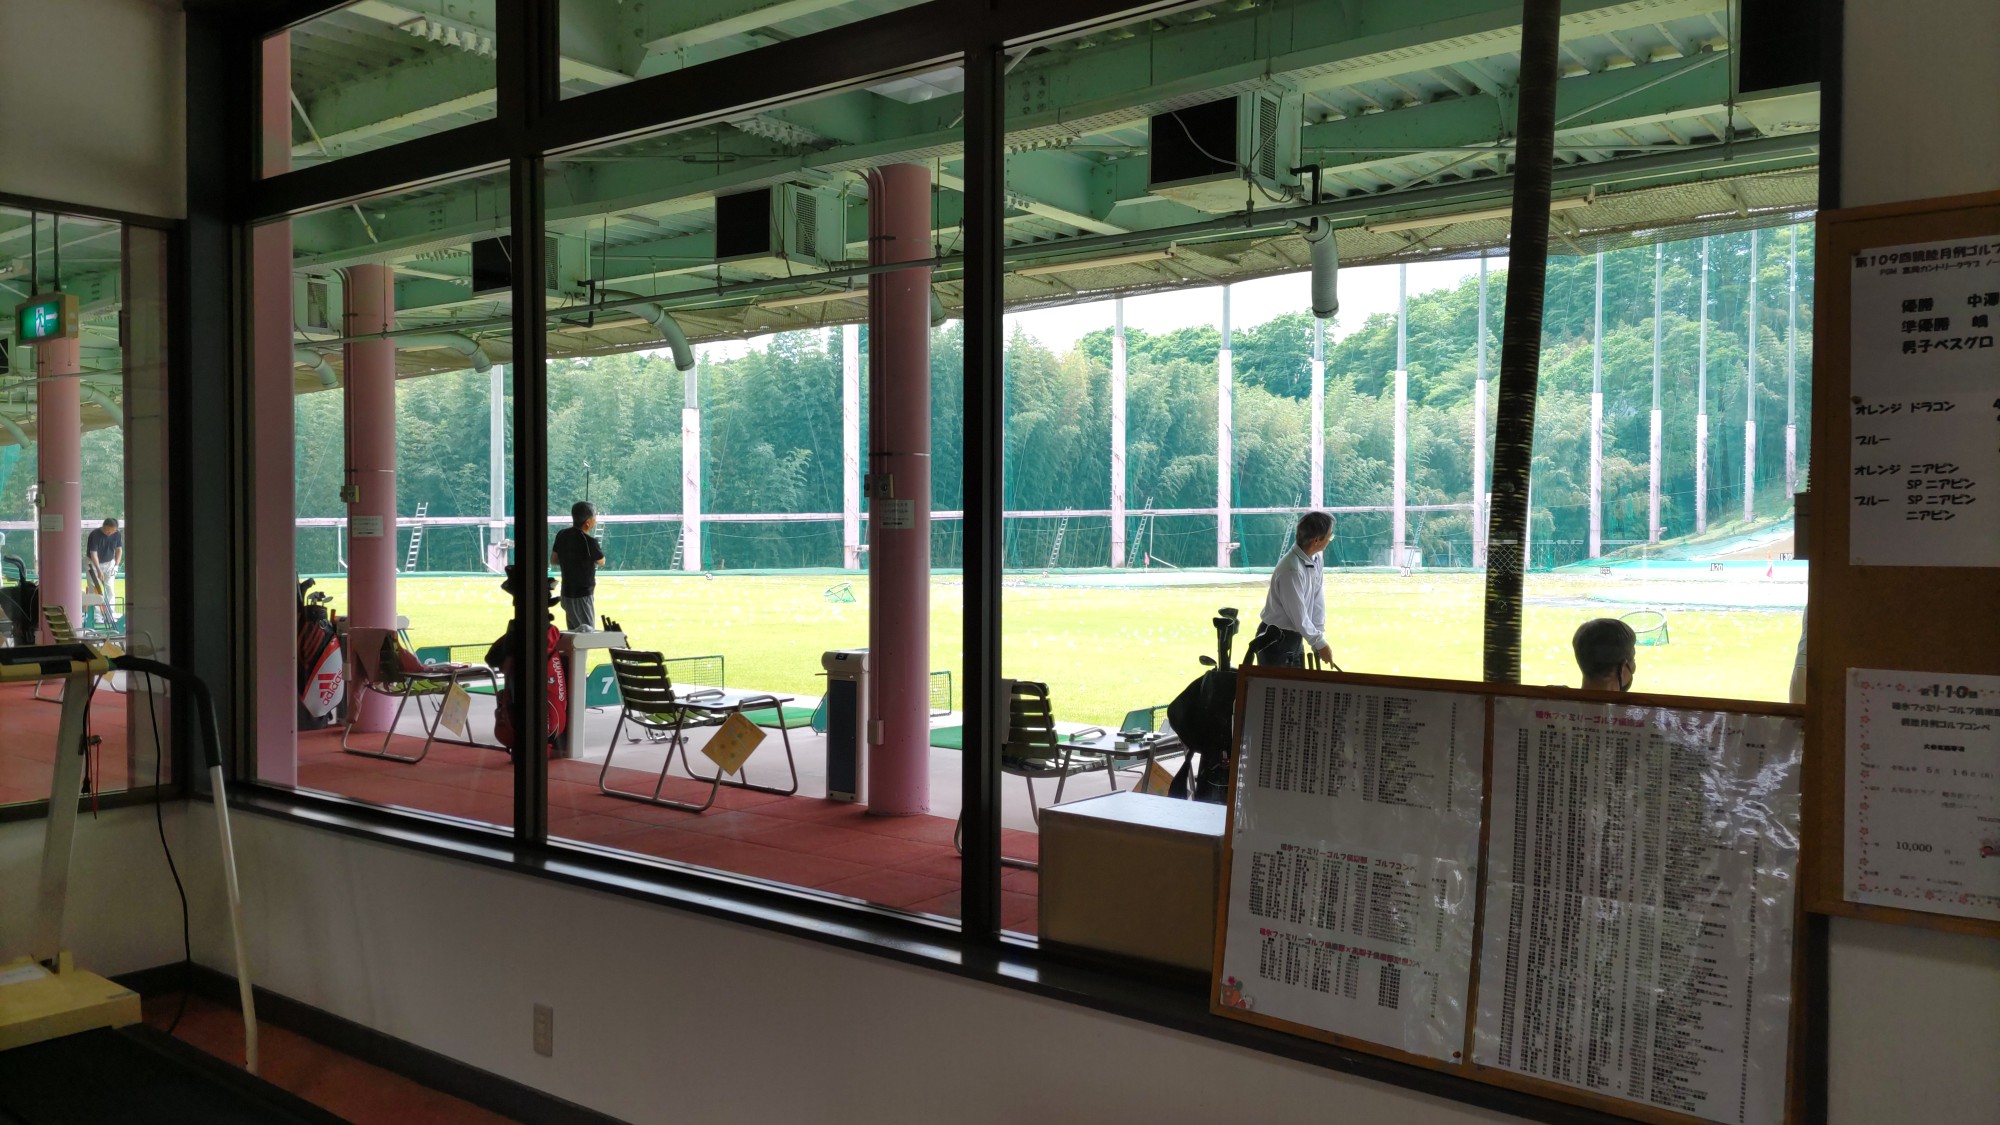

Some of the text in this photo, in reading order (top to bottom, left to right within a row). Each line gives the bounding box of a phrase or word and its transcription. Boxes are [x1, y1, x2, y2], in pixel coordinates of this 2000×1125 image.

[1902, 297, 1934, 313] 優勝
[1902, 316, 1950, 333] 準優勝
[1902, 336, 1994, 354] 男子ベスグロ
[1855, 402, 1902, 415] オレンジ
[1911, 401, 1956, 413] ドラコン
[1854, 464, 1901, 476] オレンジ
[1907, 479, 1922, 490] SP
[1907, 494, 1923, 505] SP
[322, 669, 342, 706] adidas
[601, 676, 615, 695] 7
[1896, 841, 1933, 853] 10,000
